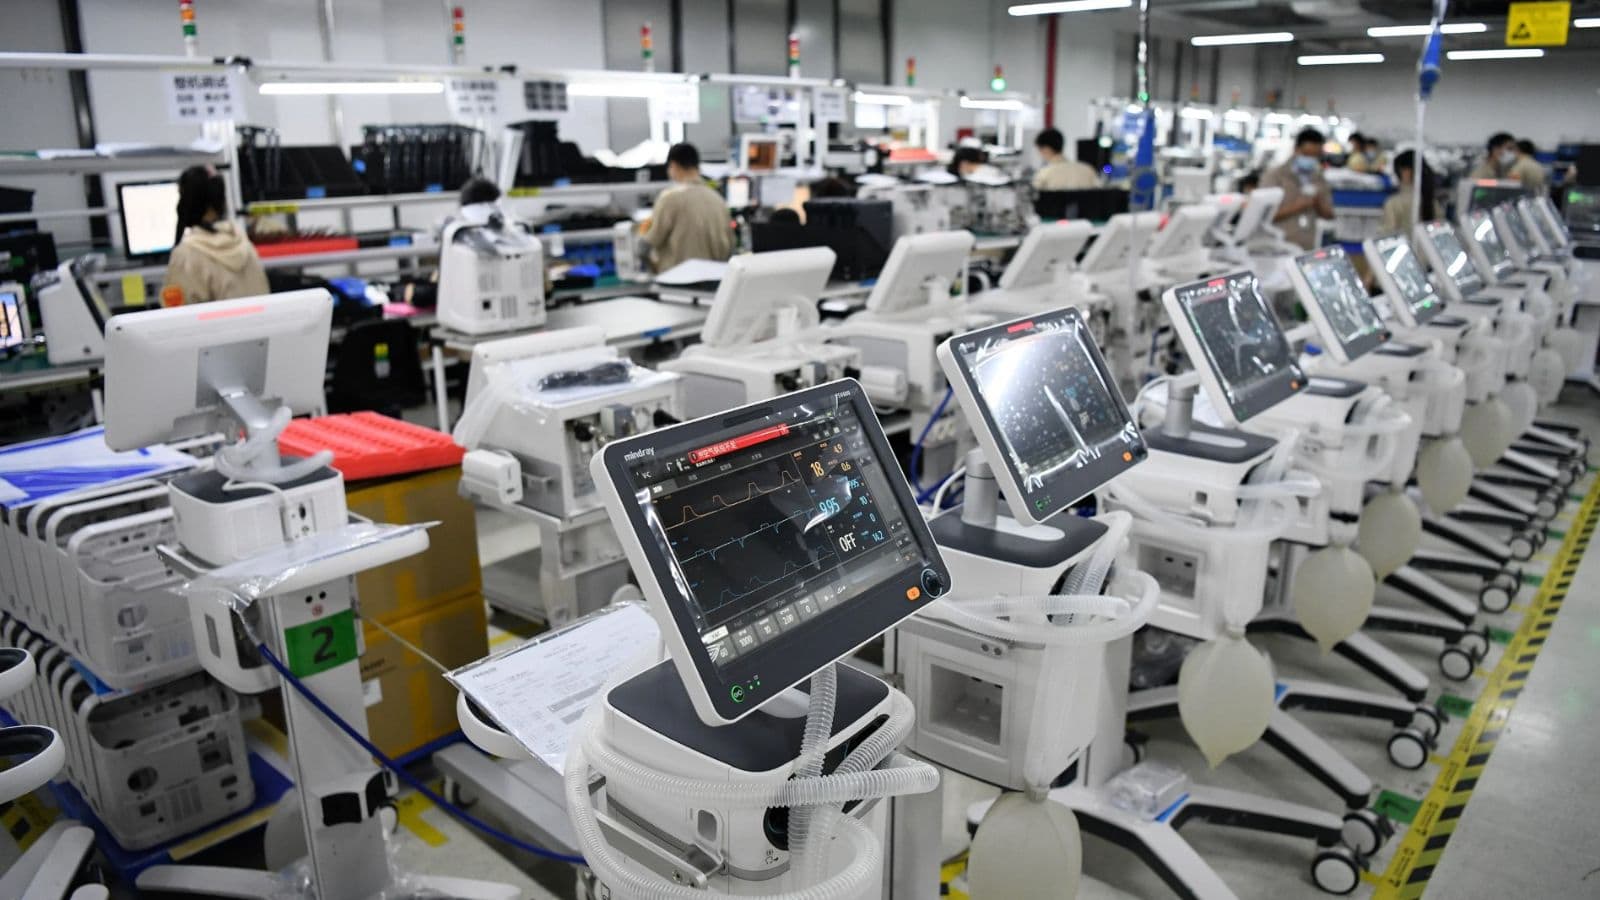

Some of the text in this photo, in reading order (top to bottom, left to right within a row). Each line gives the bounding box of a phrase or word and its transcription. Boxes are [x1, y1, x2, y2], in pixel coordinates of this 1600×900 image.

[624, 447, 654, 462] mindray
[810, 461, 825, 477] 18
[838, 532, 857, 552] OFF
[311, 625, 337, 665] 2
